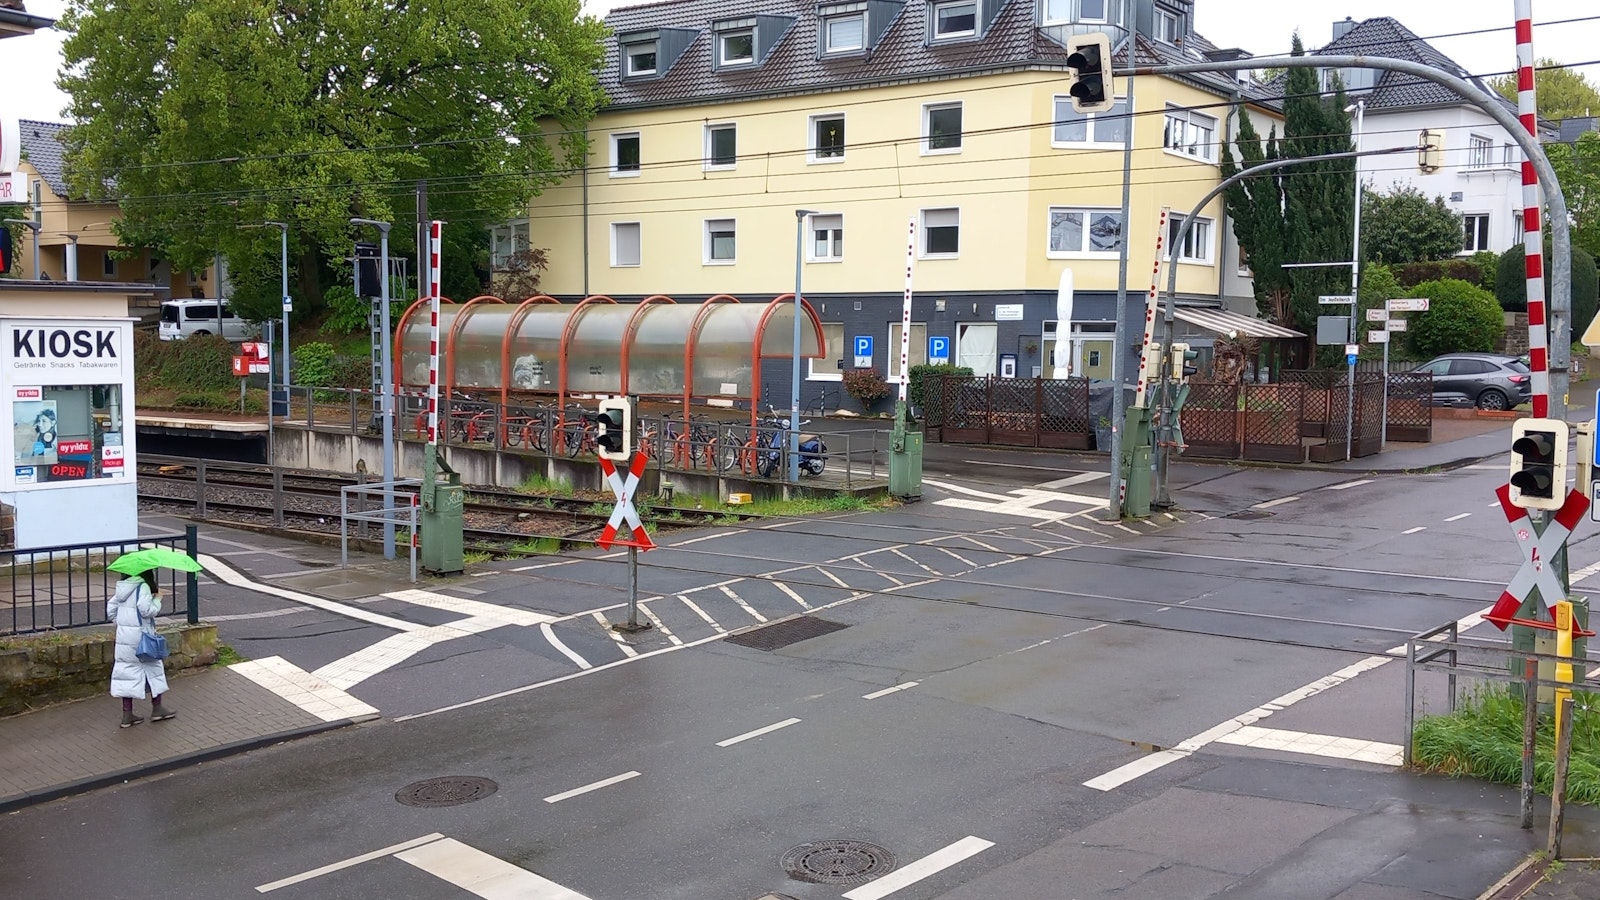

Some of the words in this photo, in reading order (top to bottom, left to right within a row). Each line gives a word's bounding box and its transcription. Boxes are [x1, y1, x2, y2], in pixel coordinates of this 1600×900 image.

[13, 329, 117, 358] KIOSK
[859, 339, 868, 355] P
[933, 340, 944, 356] P
[14, 361, 46, 369] Getränke
[60, 444, 69, 453] ay
[51, 465, 86, 477] OPEN
